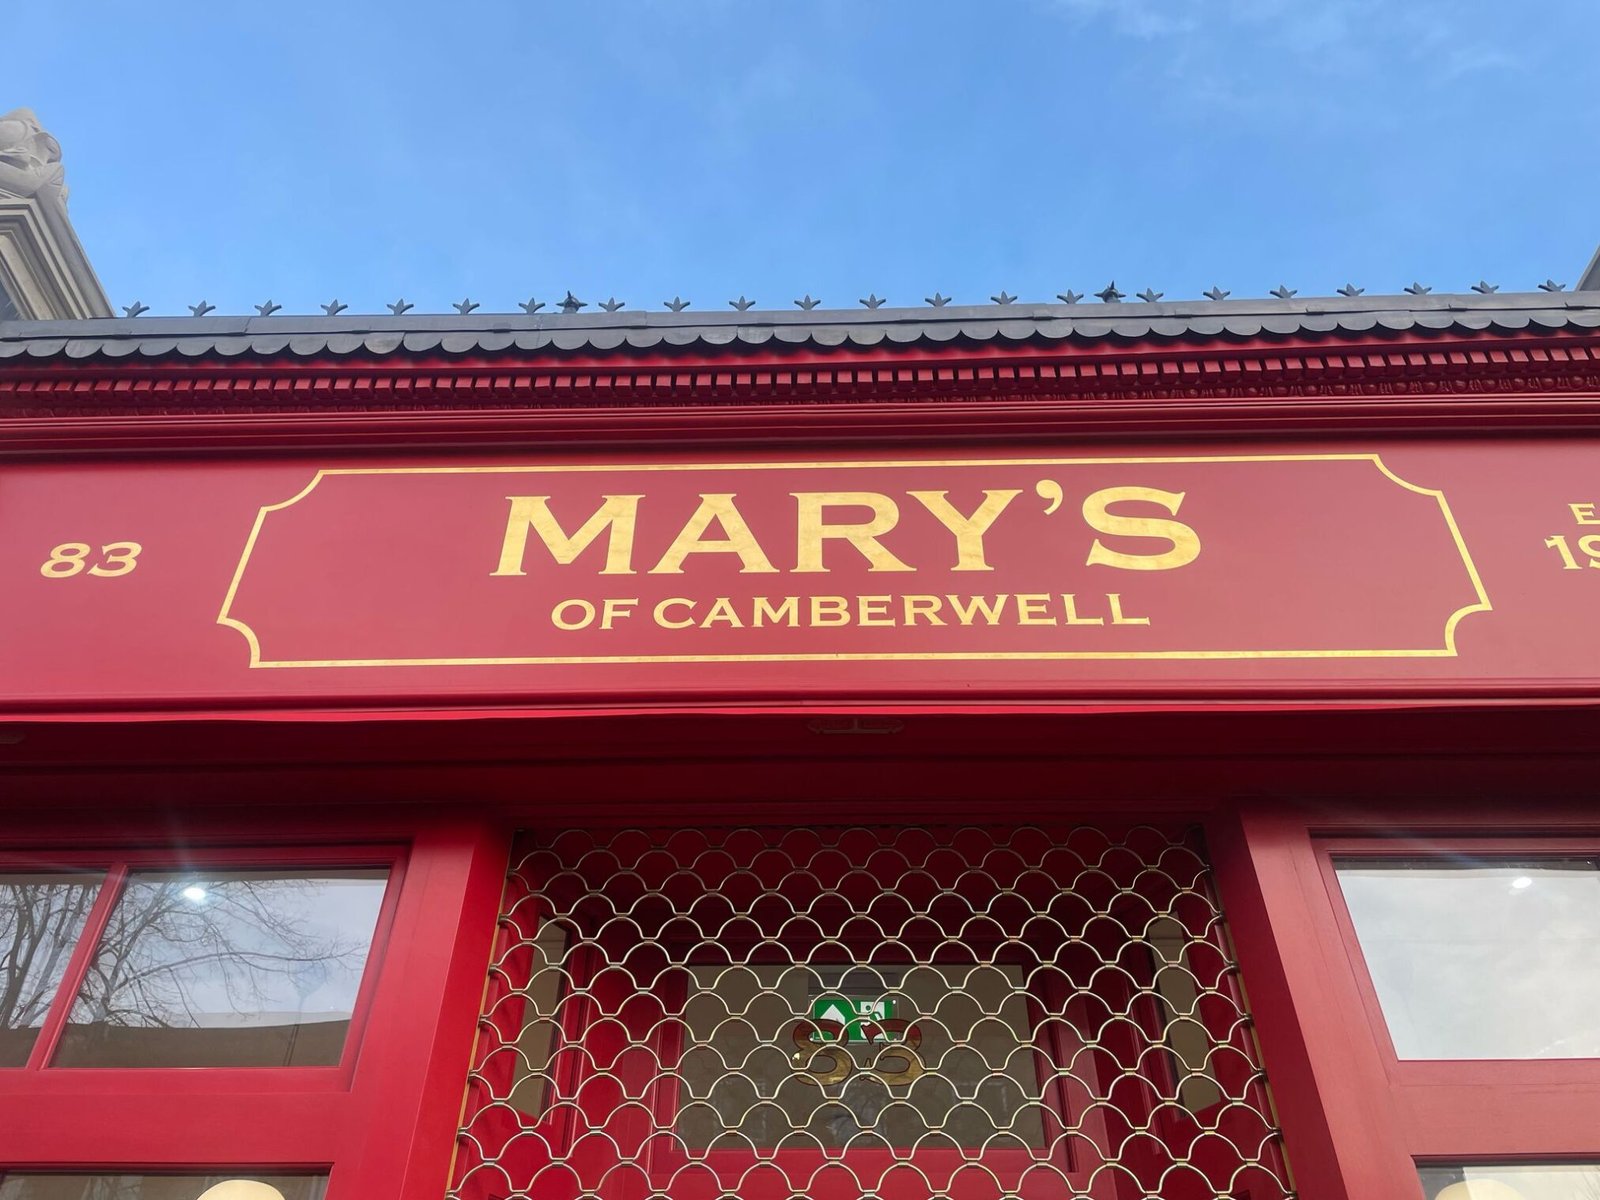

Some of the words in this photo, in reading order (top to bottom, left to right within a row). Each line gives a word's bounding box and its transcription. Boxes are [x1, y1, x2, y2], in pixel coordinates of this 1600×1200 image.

[490, 479, 1203, 577] MARY'S
[40, 541, 142, 579] 83
[550, 597, 639, 631] OF
[652, 592, 1151, 630] CAMBERWELL
[792, 1018, 926, 1087] 83
